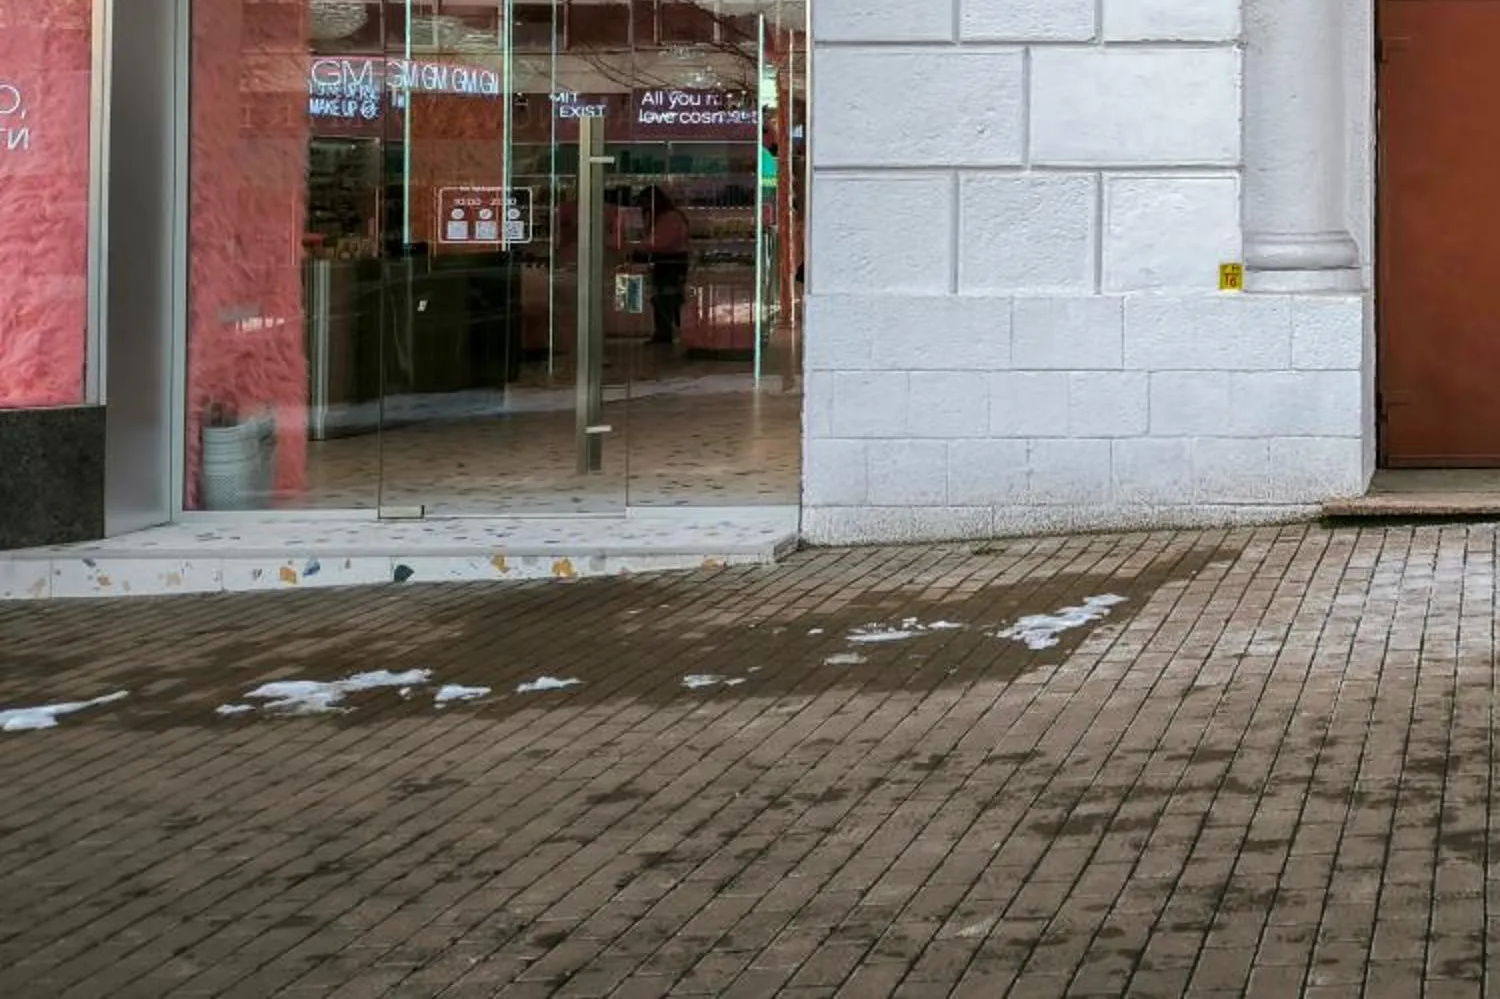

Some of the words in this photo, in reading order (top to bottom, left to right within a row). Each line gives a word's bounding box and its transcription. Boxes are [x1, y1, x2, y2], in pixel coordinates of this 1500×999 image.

[311, 60, 374, 89] GM
[641, 91, 664, 106] All
[668, 91, 701, 110] you
[559, 104, 607, 118] EXIST
